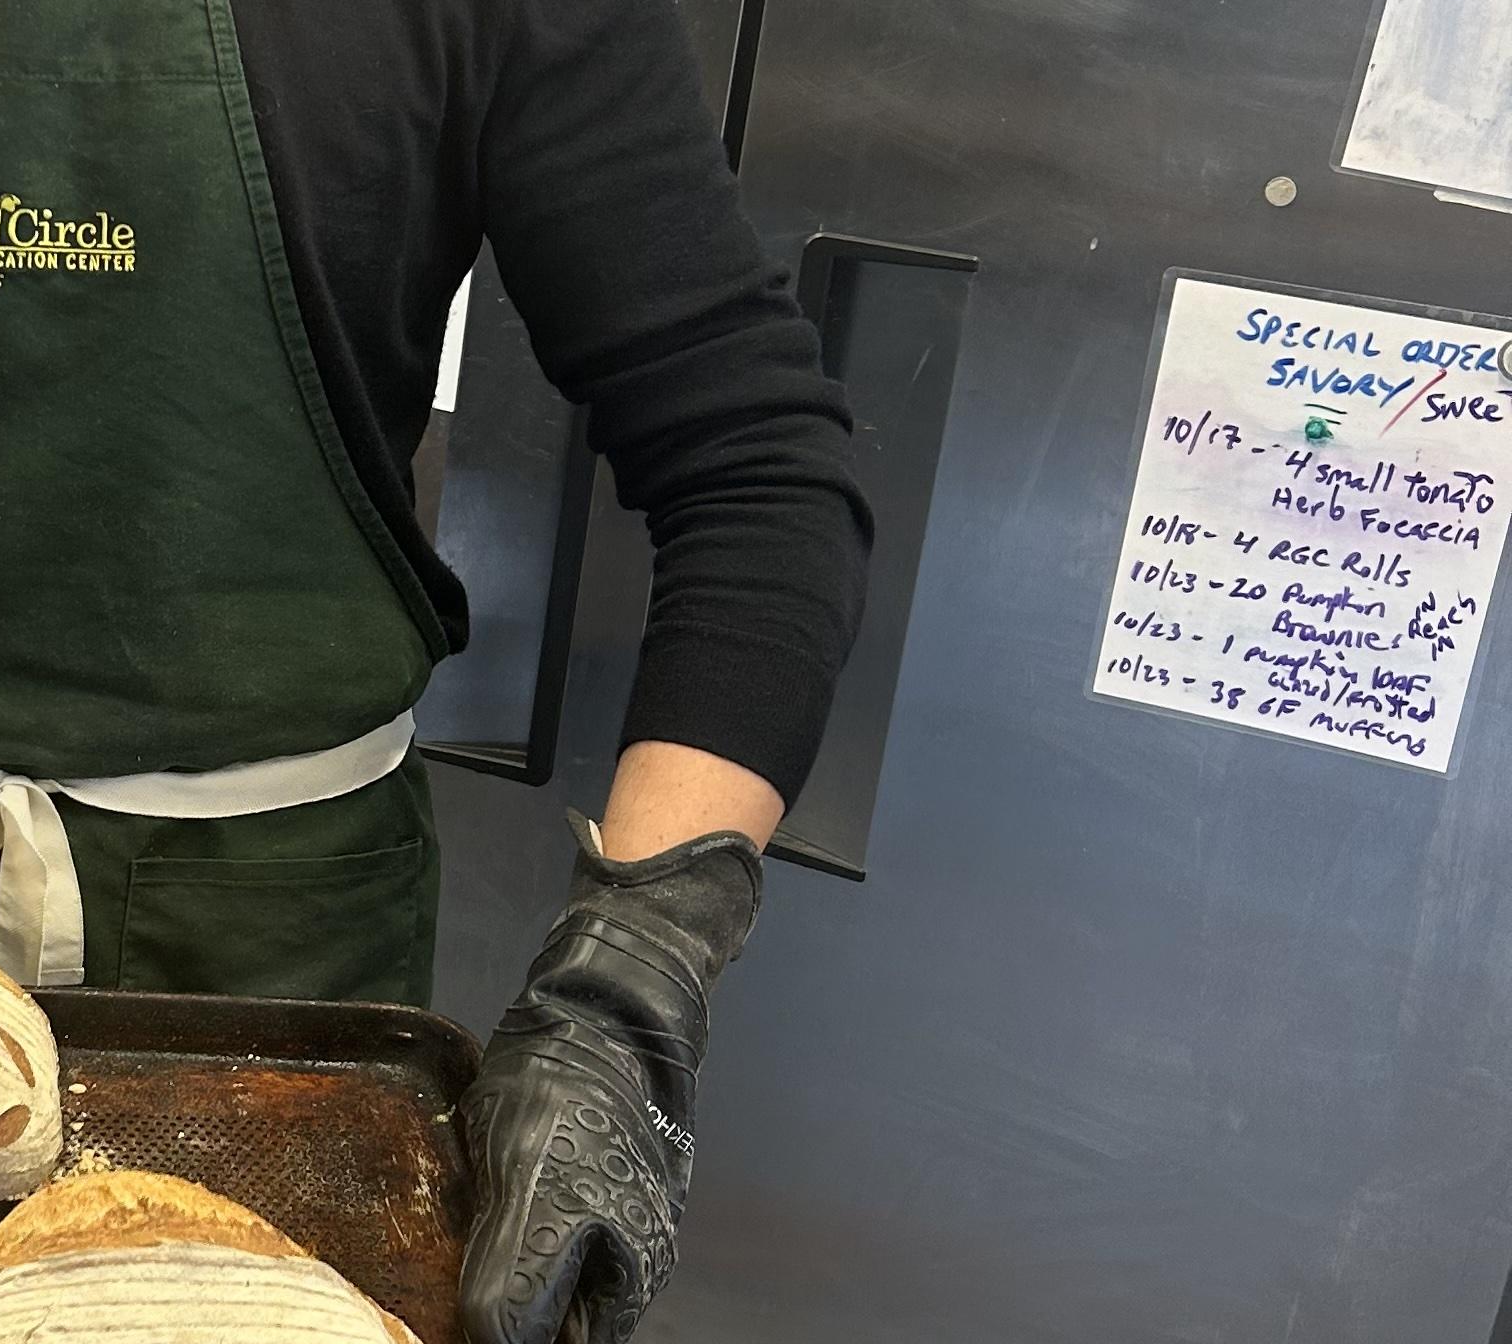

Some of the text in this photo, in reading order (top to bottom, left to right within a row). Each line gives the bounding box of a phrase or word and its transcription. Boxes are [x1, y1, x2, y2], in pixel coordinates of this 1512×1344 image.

[7, 208, 135, 250] Circle
[65, 253, 136, 272] CENTER
[1237, 308, 1381, 358] SPECIAL
[1266, 357, 1415, 408] SAVORY
[1315, 461, 1396, 493] small
[1272, 484, 1346, 521] Herb
[1130, 558, 1198, 594] 10/23
[1228, 577, 1267, 600] 20
[1233, 531, 1259, 554] 4
[1268, 540, 1330, 567] RGC
[1341, 552, 1412, 588] Rolls
[1113, 611, 1182, 641] 10/23
[1107, 654, 1171, 686] 10/23
[1210, 680, 1248, 711] 38
